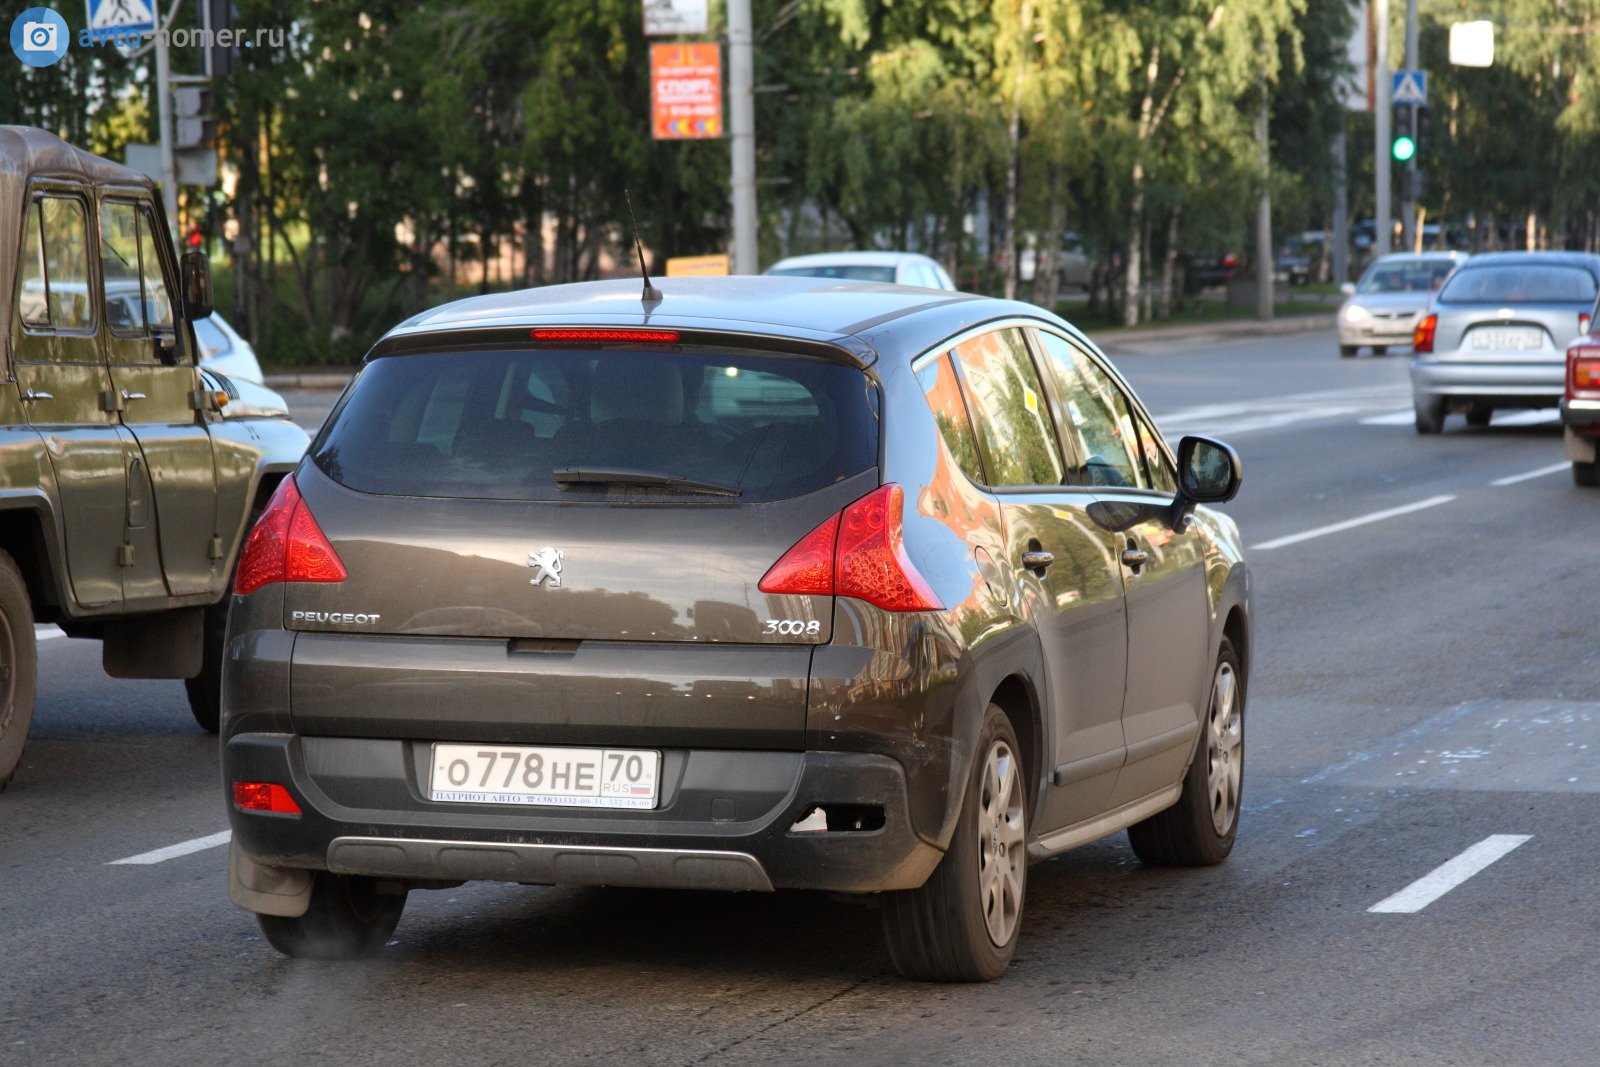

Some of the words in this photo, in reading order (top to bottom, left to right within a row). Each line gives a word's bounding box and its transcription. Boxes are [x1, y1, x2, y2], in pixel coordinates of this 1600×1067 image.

[291, 610, 381, 625] PEUGEOT
[762, 619, 821, 636] 3008
[608, 753, 643, 783] 70
[603, 783, 630, 794] RUS
[435, 791, 487, 802] ПАТРИОТ
[490, 795, 521, 804] АВТО
